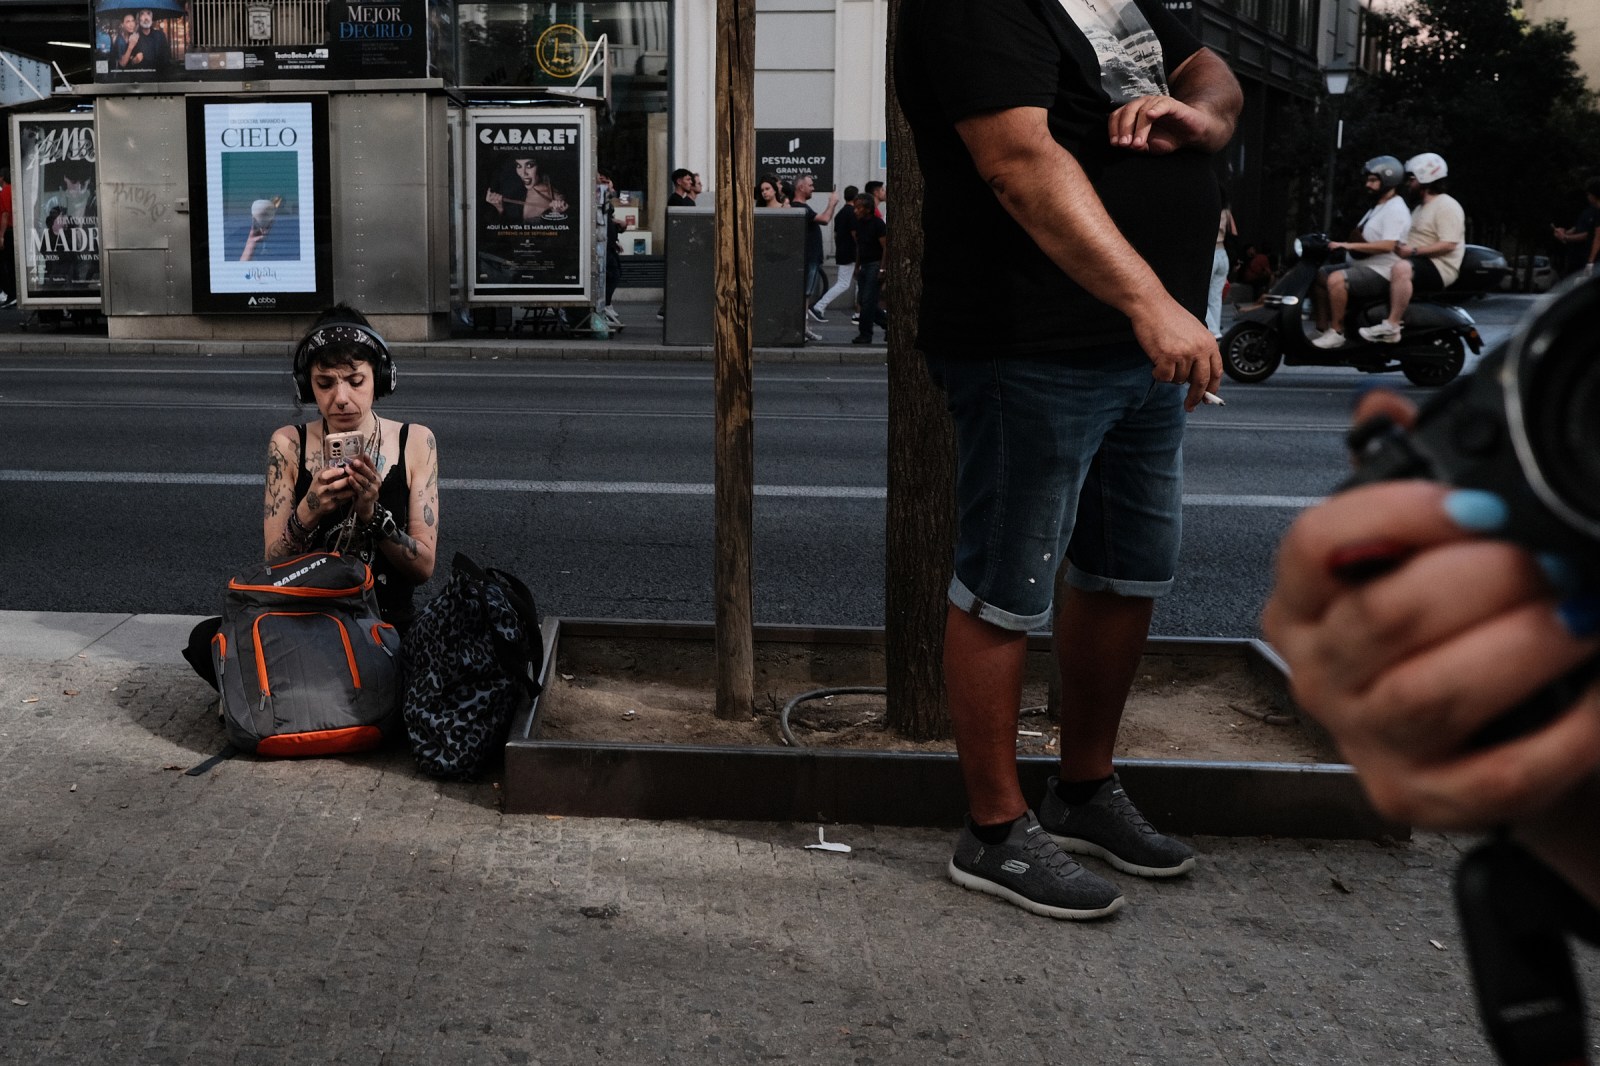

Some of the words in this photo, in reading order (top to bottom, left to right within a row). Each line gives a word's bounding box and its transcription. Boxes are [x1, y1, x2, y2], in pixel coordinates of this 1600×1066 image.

[348, 5, 401, 23] MEJOR
[1162, 1, 1193, 10] IMAS
[339, 22, 413, 39] DECIRLO
[221, 127, 297, 148] CIELO
[479, 128, 577, 144] CABARET
[761, 156, 806, 165] PESTANA
[807, 156, 826, 165] CR7
[30, 227, 99, 252] MADR
[273, 557, 327, 587] BASIC-FIT
